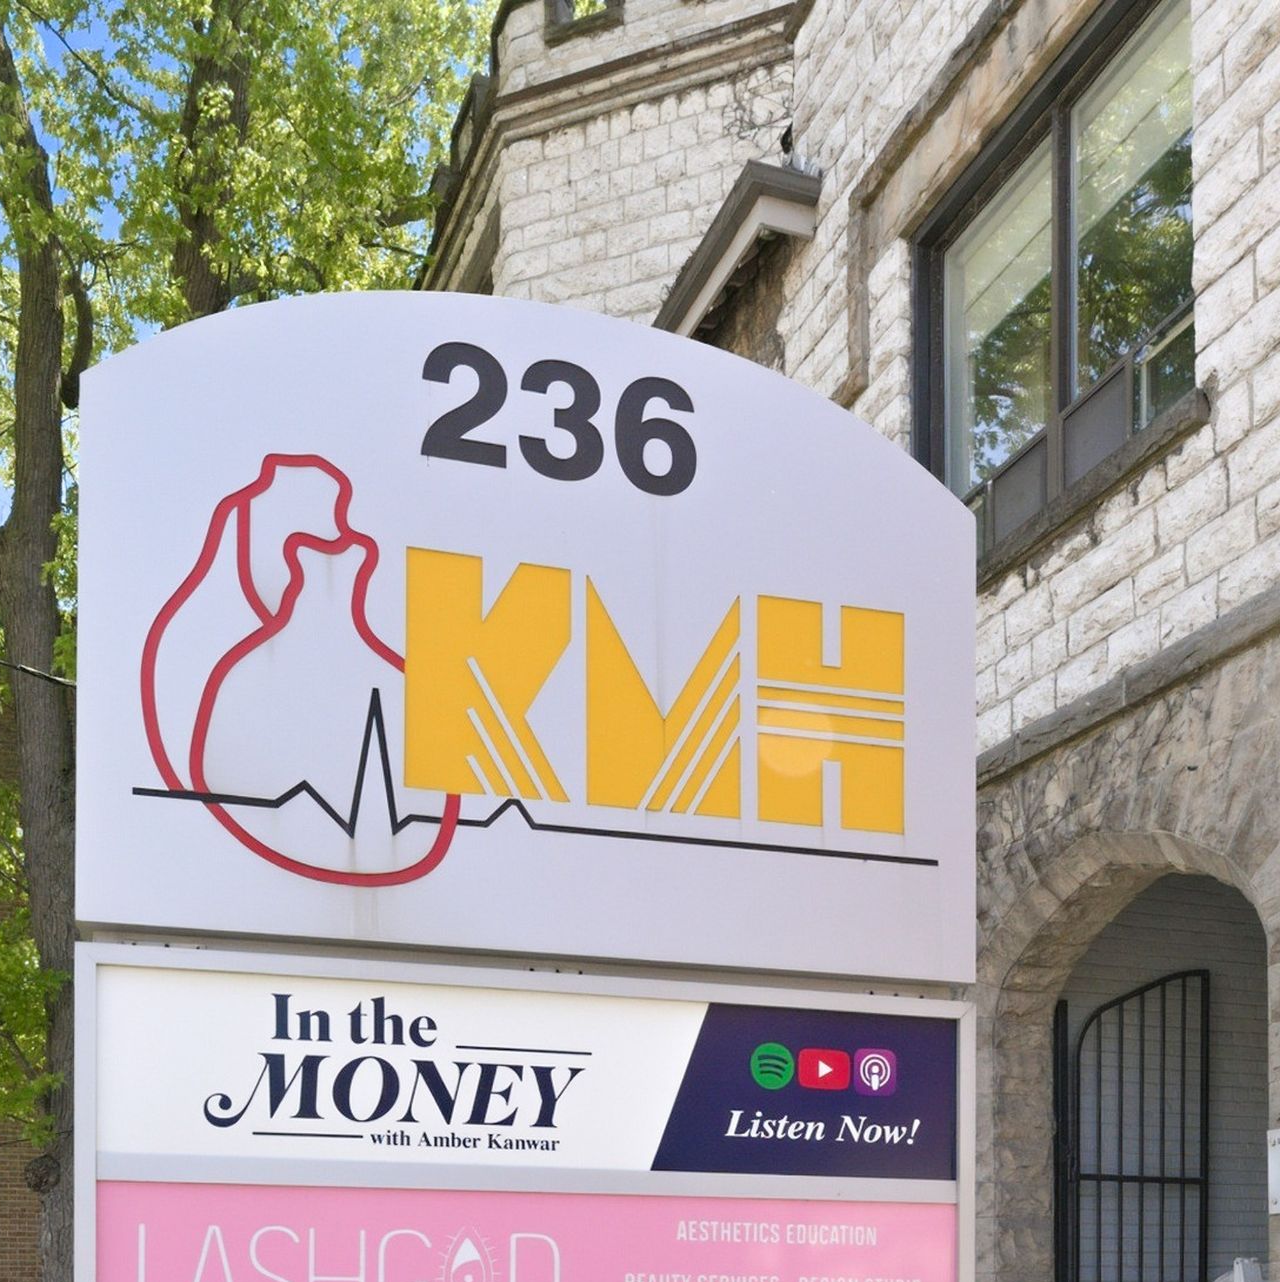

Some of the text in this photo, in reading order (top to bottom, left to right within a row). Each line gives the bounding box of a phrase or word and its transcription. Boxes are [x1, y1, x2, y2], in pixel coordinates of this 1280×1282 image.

[420, 341, 697, 497] 236
[405, 546, 905, 835] KMH
[271, 993, 438, 1048] In the
[203, 1052, 587, 1128] MONEY
[370, 1130, 560, 1152] with Amber Kanwar
[725, 1110, 921, 1145] Listen Now!
[676, 1220, 877, 1246] AESTHETICS EDUCATION
